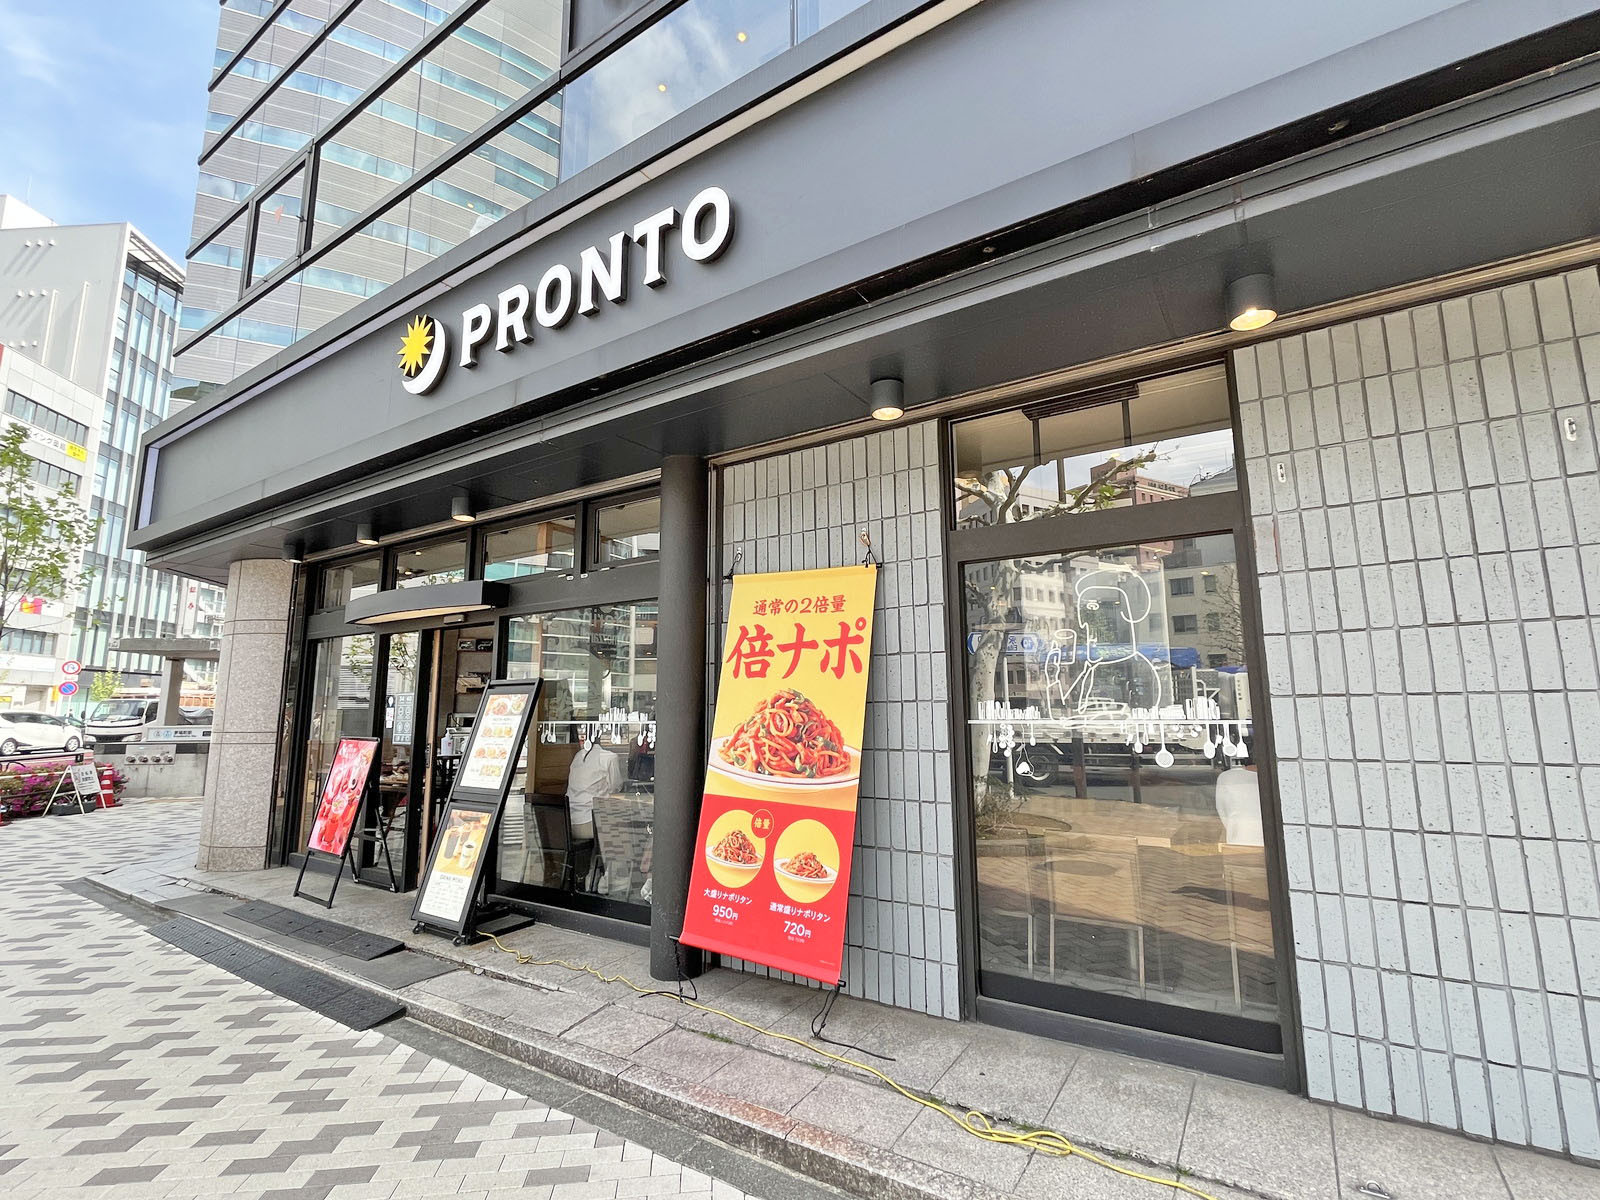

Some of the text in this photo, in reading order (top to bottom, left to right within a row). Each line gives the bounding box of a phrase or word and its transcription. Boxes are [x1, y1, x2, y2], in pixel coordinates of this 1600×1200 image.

[459, 186, 733, 368] PRONTO
[752, 594, 847, 617] 通常の2倍量
[726, 617, 867, 680] 倍ナポ
[754, 817, 771, 830] 倍量
[703, 888, 753, 905] 大盛りナポリタン
[712, 904, 739, 921] 950円
[769, 902, 831, 923] 通常盛りナポリタン
[783, 921, 812, 939] 720円
